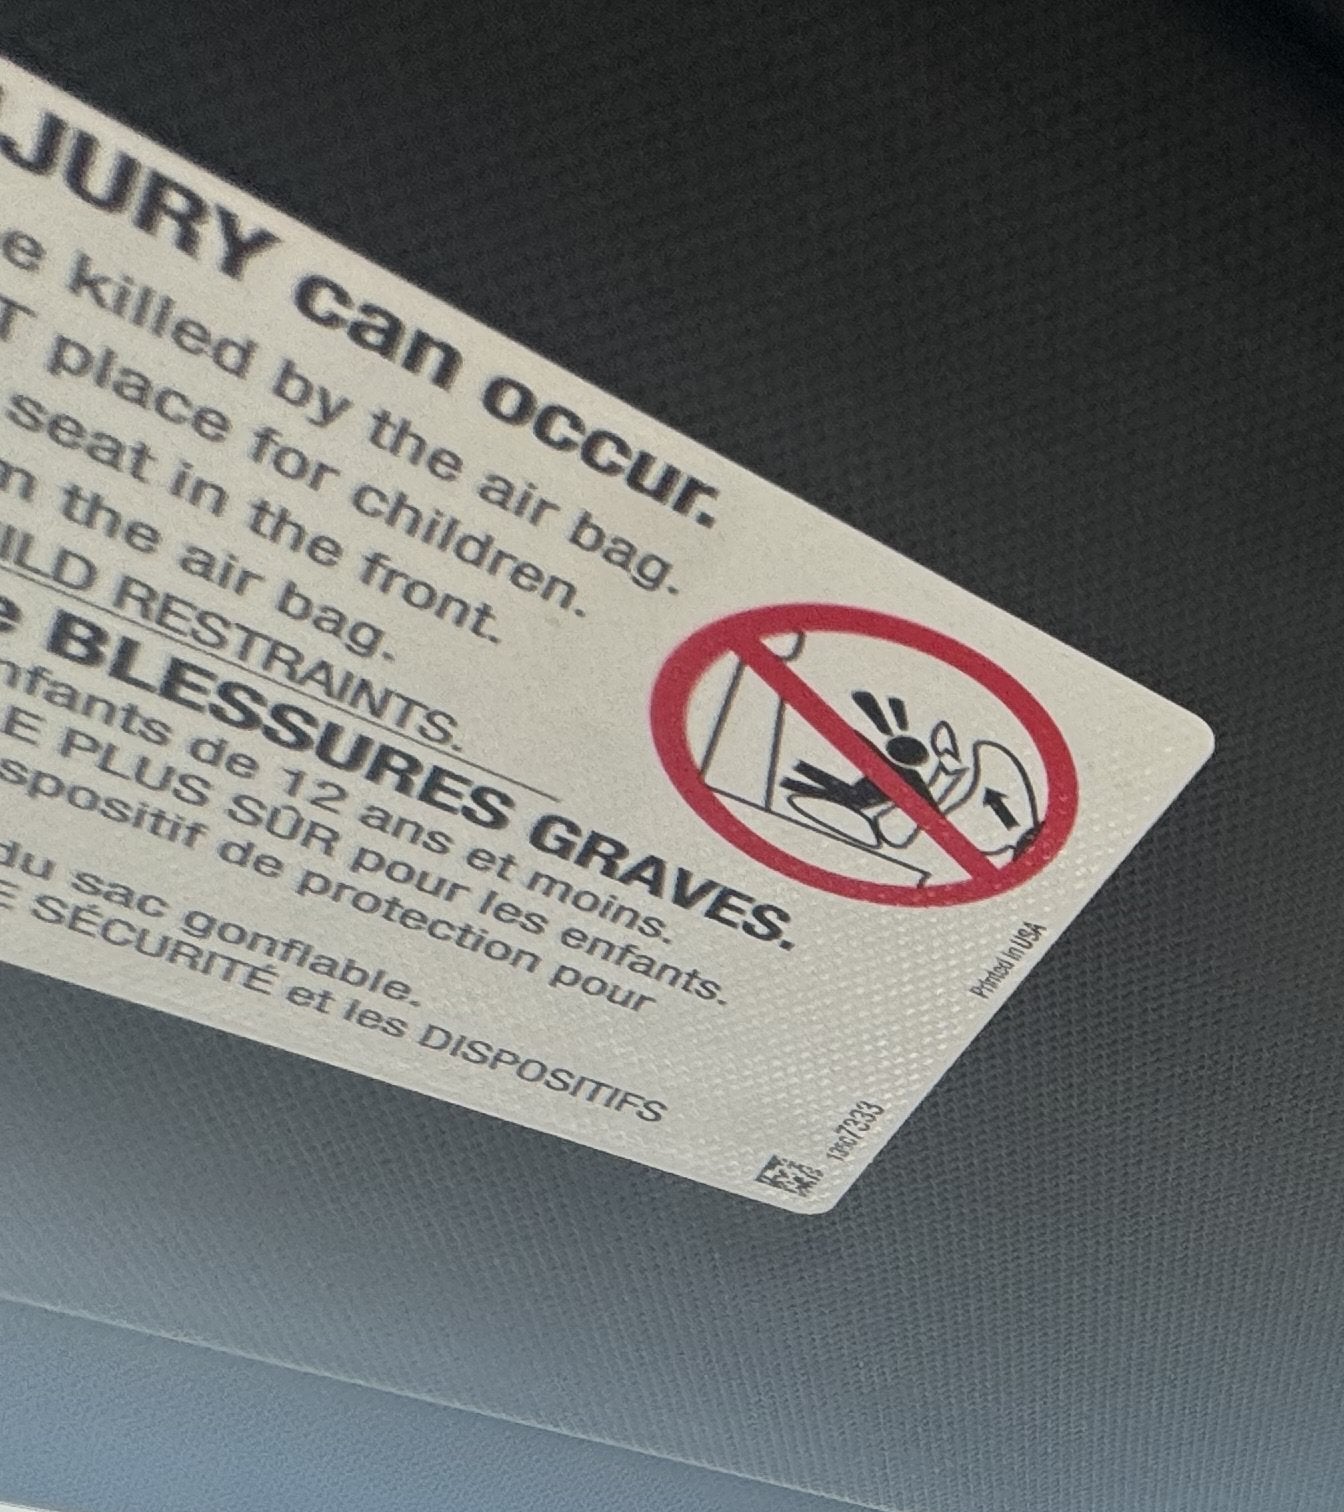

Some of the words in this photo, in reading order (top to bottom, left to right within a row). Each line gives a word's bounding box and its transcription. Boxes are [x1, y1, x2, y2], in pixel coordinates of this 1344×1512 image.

[47, 334, 231, 442] place
[252, 427, 340, 491] for
[351, 484, 586, 618] children.
[68, 251, 258, 379] killed
[272, 358, 352, 428] by
[369, 409, 463, 482] the
[478, 474, 560, 526] air
[568, 510, 679, 595] bag.
[294, 275, 462, 392] can
[482, 376, 719, 529] occur.
[6, 394, 156, 483] seat
[170, 470, 229, 517] in
[249, 499, 343, 567] the
[360, 552, 501, 645] front.
[62, 484, 162, 554] the
[179, 545, 264, 596] air
[276, 580, 394, 661] bag.
[113, 575, 462, 751] RESTRAINTS.
[47, 610, 515, 830] BLESSURES
[529, 815, 795, 951] GRAVES.
[59, 728, 212, 806] PLUS
[227, 794, 340, 857] SÛR
[350, 847, 471, 901] pour
[479, 890, 548, 934] les
[561, 928, 727, 1006] enfants.
[189, 738, 259, 779] de
[283, 769, 348, 814] 12
[358, 805, 453, 854] ans
[466, 848, 517, 881] et
[526, 871, 671, 944] moins.
[31, 895, 277, 995] SÉCURITÉ
[286, 987, 334, 1014] et
[343, 1000, 408, 1037] les
[418, 1024, 668, 1122] DISPOSITIFS
[71, 872, 168, 917] sac
[182, 911, 420, 1007] gonflable.
[218, 842, 283, 878] de
[296, 870, 541, 973] protection
[549, 965, 656, 1012] pour
[1009, 921, 1046, 951] USA
